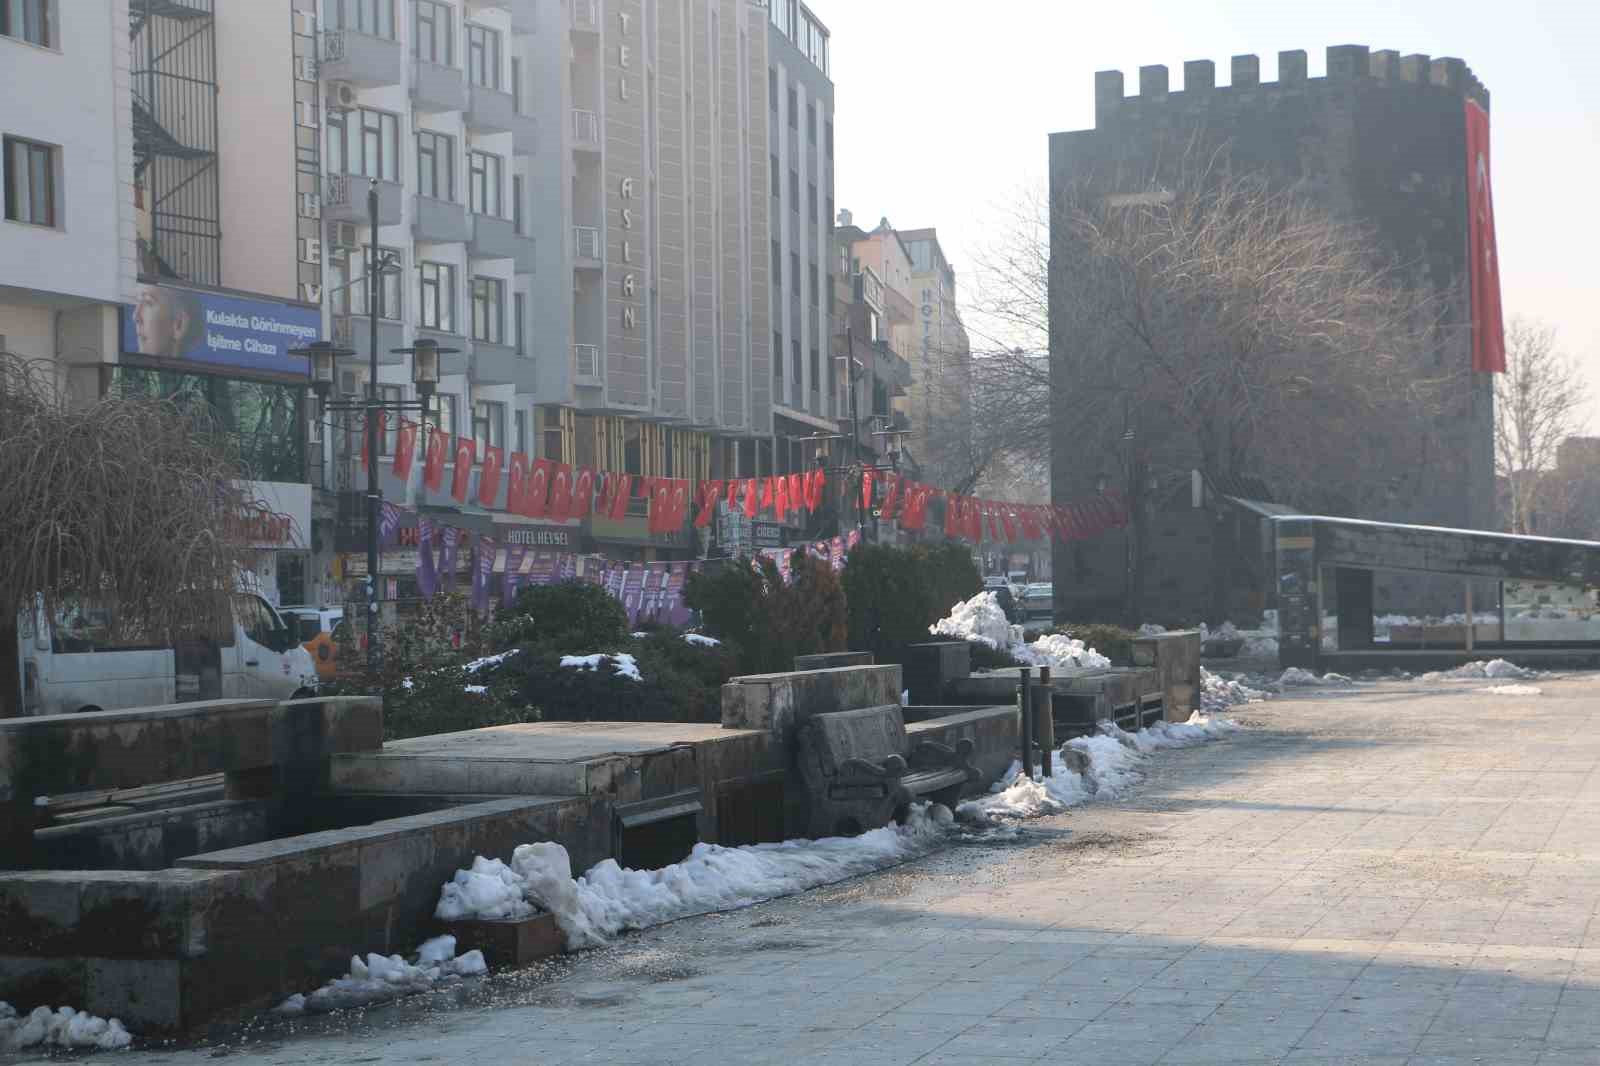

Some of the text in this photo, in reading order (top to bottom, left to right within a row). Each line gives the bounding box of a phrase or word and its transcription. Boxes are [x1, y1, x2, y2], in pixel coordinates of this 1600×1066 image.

[621, 176, 635, 330] ASLAN
[206, 309, 317, 339] Kulakta Görünmeyen
[207, 328, 278, 356] İşitme Cihazı
[507, 529, 537, 545] HOTEL
